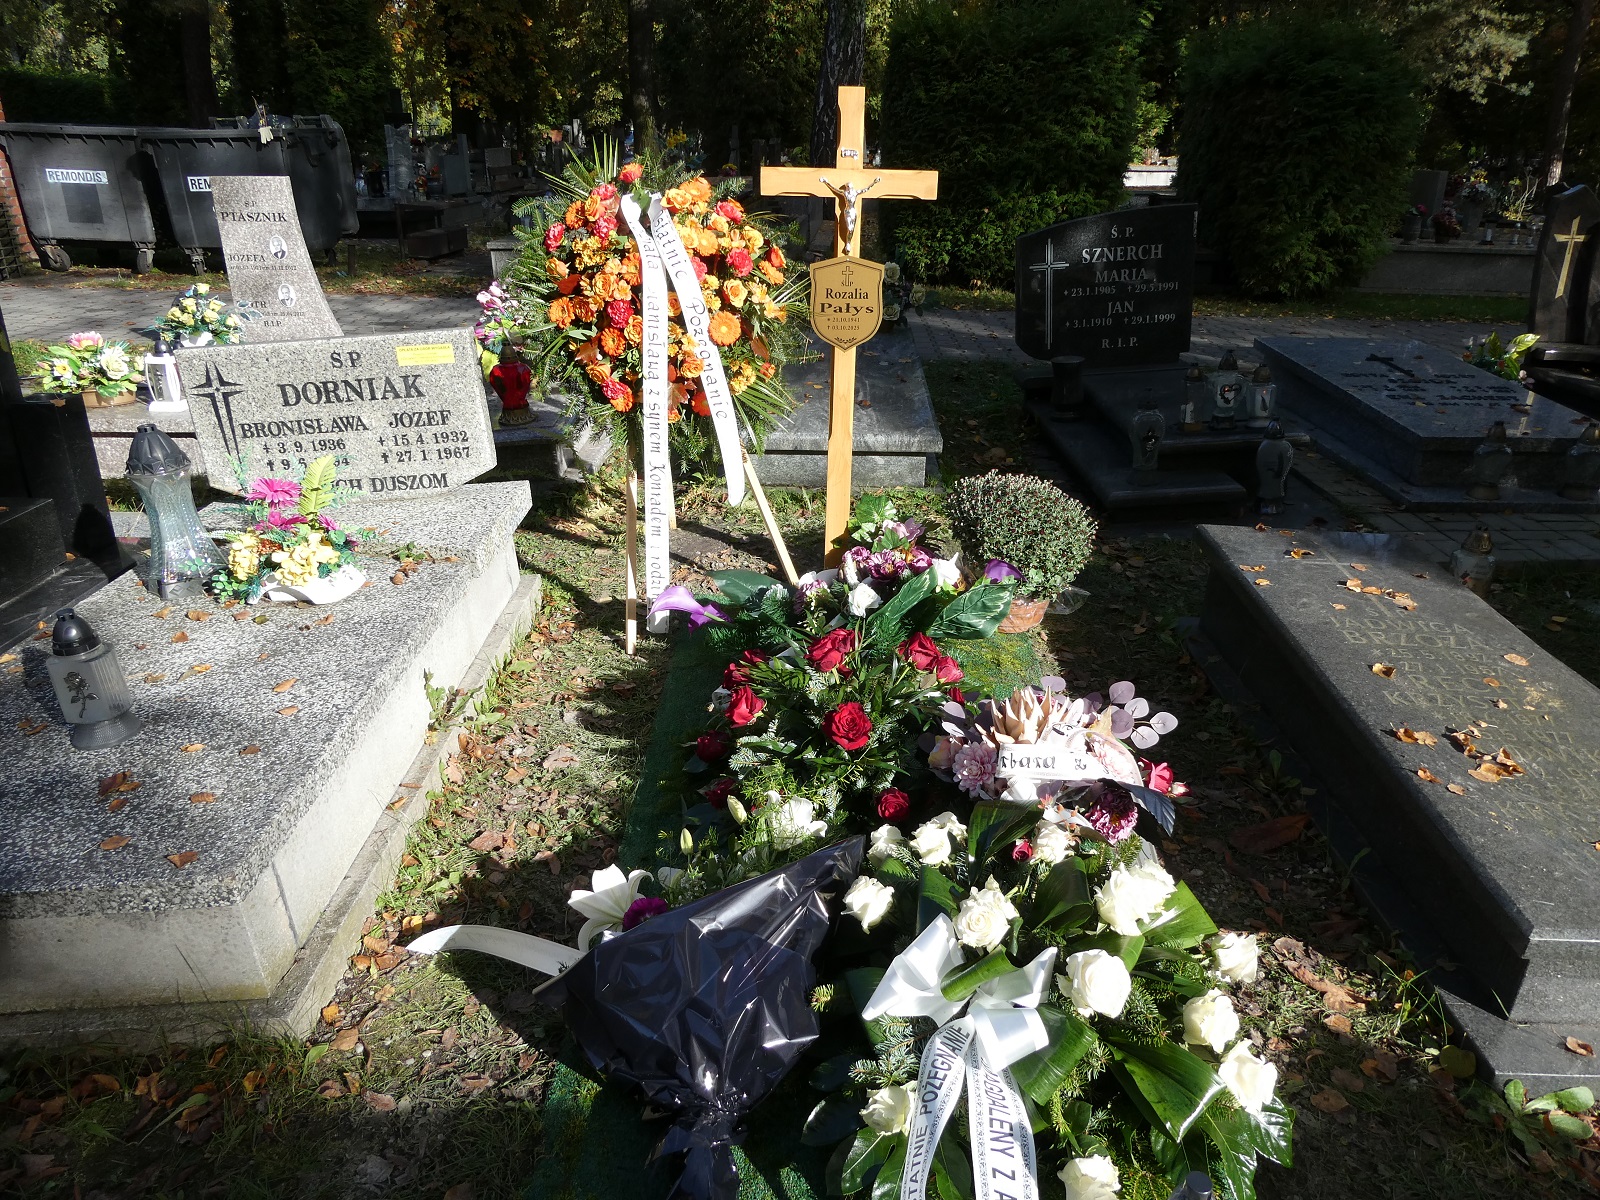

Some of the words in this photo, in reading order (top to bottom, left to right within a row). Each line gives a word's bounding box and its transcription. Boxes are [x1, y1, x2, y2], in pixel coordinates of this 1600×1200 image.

[47, 170, 103, 183] REMONDIS
[220, 211, 287, 223] PTASZNIK
[1082, 244, 1163, 264] SZNERCH
[1095, 268, 1147, 283] MARIA
[825, 287, 869, 300] Rozalia
[819, 302, 874, 316] Pałys
[1107, 301, 1135, 317] JAN
[277, 374, 426, 407] DORNIAK
[238, 415, 369, 439] BRONISŁAWA
[645, 402, 662, 454] synem
[371, 473, 449, 493] DUSZOM
[648, 460, 667, 537] Konradem
[907, 1124, 928, 1200] TATNIE
[920, 1025, 971, 1116] POŻEGNANIE
[991, 1166, 1016, 1182] Z
